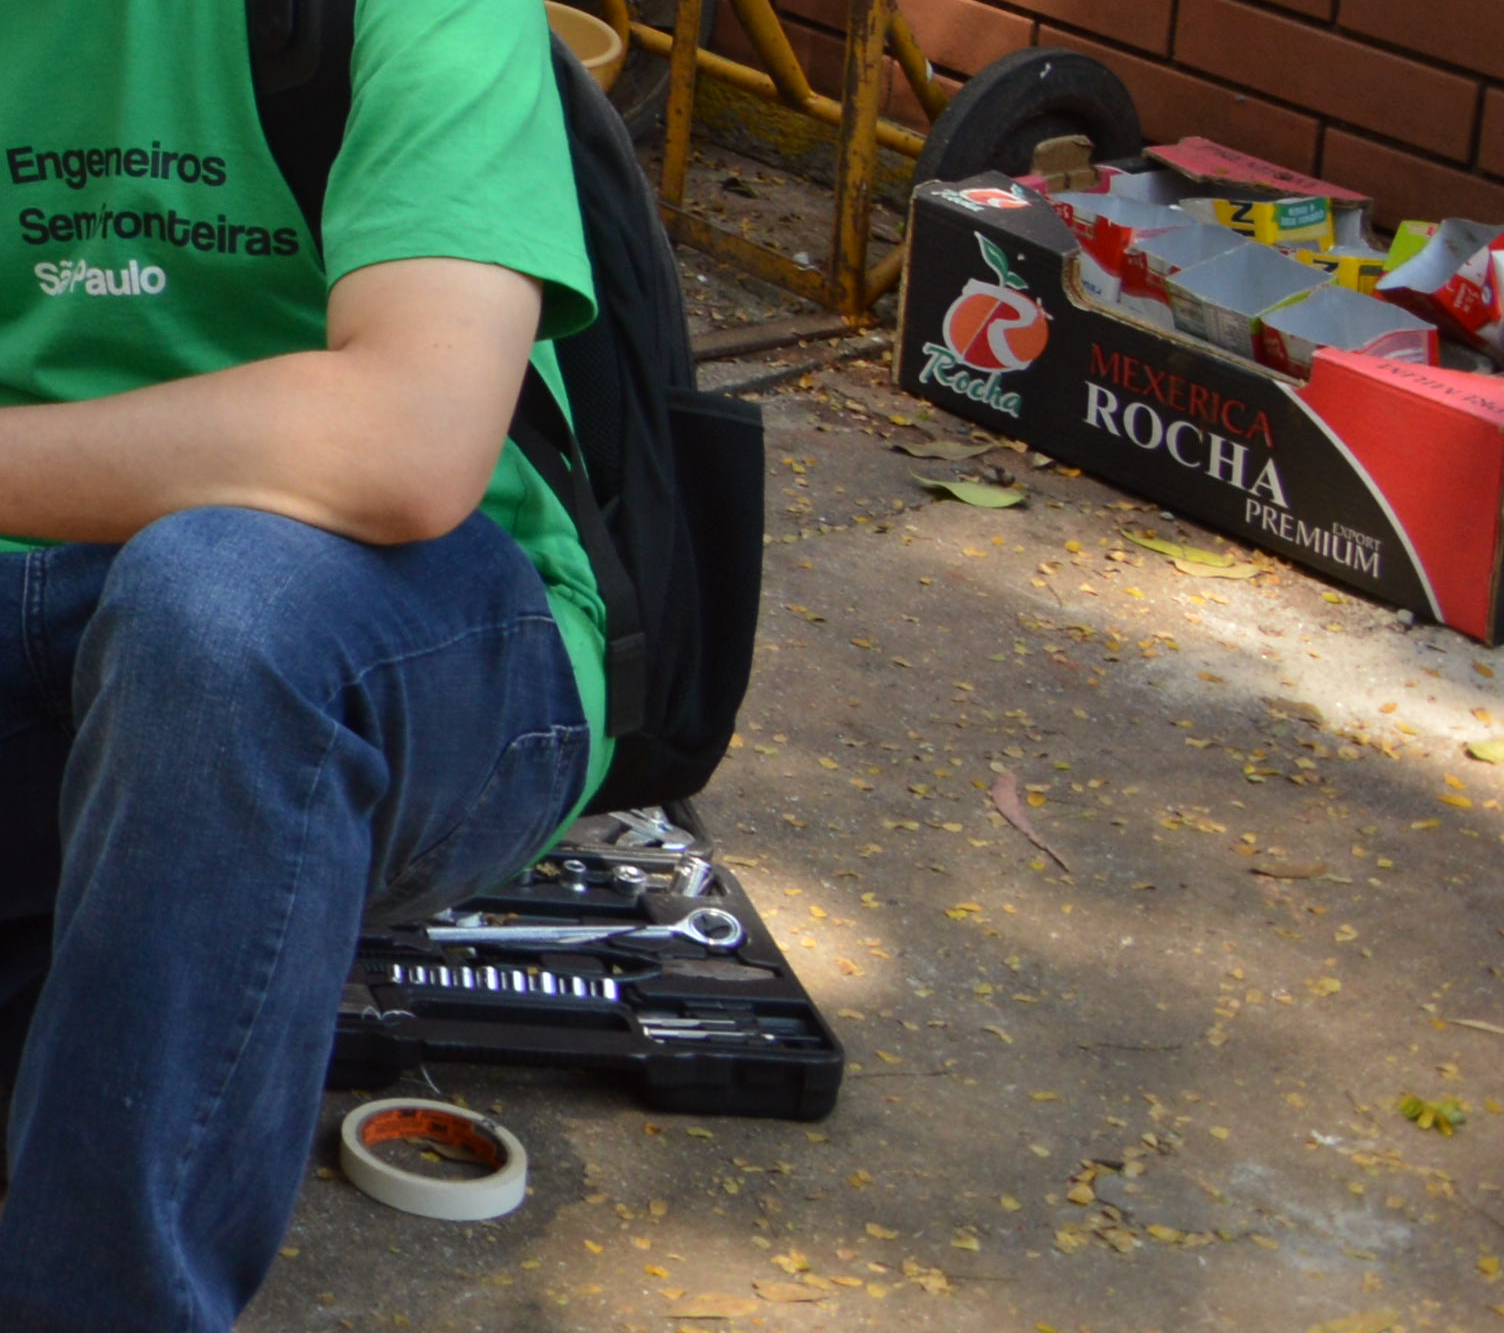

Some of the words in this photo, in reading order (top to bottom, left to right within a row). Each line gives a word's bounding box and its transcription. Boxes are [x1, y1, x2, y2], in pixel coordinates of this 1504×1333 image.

[919, 341, 1023, 419] Rocha
[1089, 342, 1275, 449] MEXERICA
[1083, 380, 1289, 509] ROCHA
[1245, 497, 1380, 579] PREMIUM
[1332, 521, 1382, 552] EXPORT
